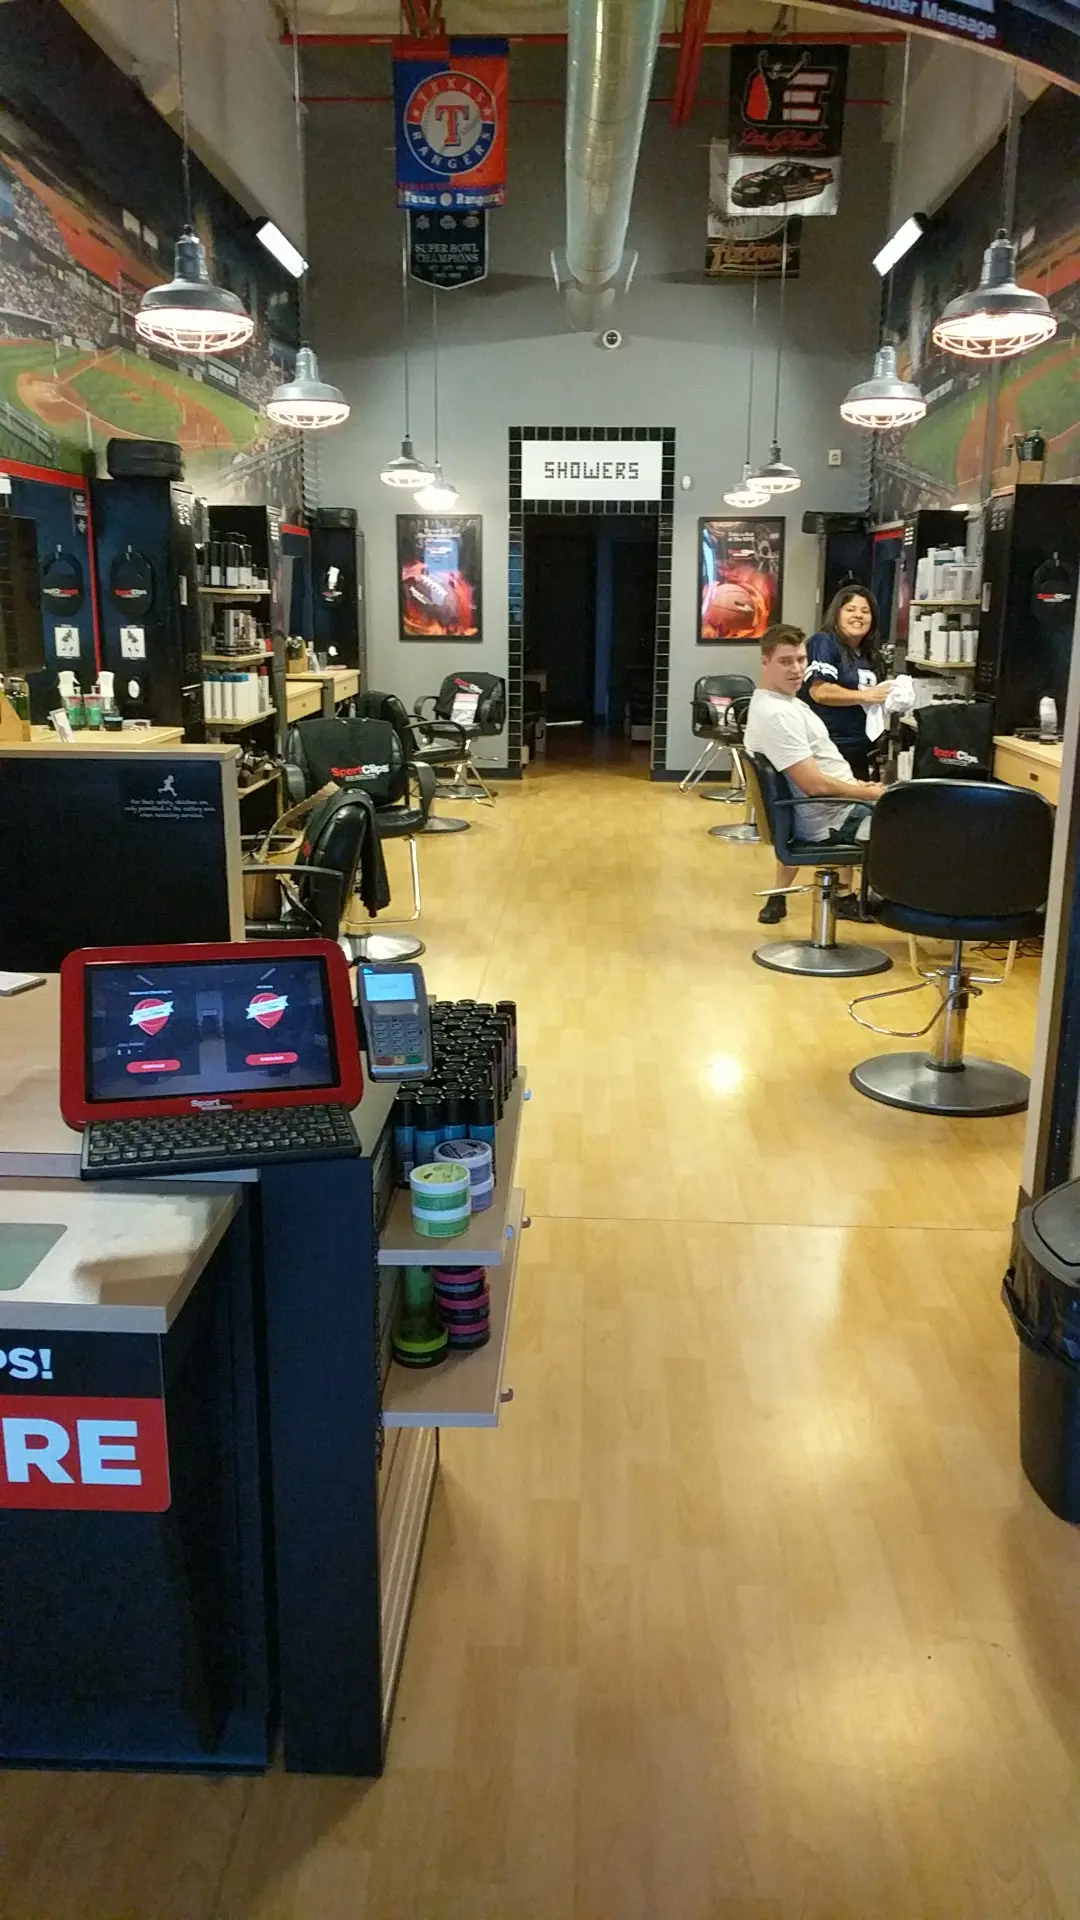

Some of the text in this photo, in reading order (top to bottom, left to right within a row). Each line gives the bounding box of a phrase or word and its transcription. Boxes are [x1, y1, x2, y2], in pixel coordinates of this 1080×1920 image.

[921, 2, 997, 40] Massage
[416, 77, 486, 101] TEXAS
[411, 131, 491, 169] RANGERS
[404, 191, 437, 205] Texas
[415, 243, 480, 253] SUPER BOWL
[415, 253, 480, 263] CHAMPIONS
[544, 461, 639, 480] SHOWERS
[2, 1417, 142, 1486] RE
